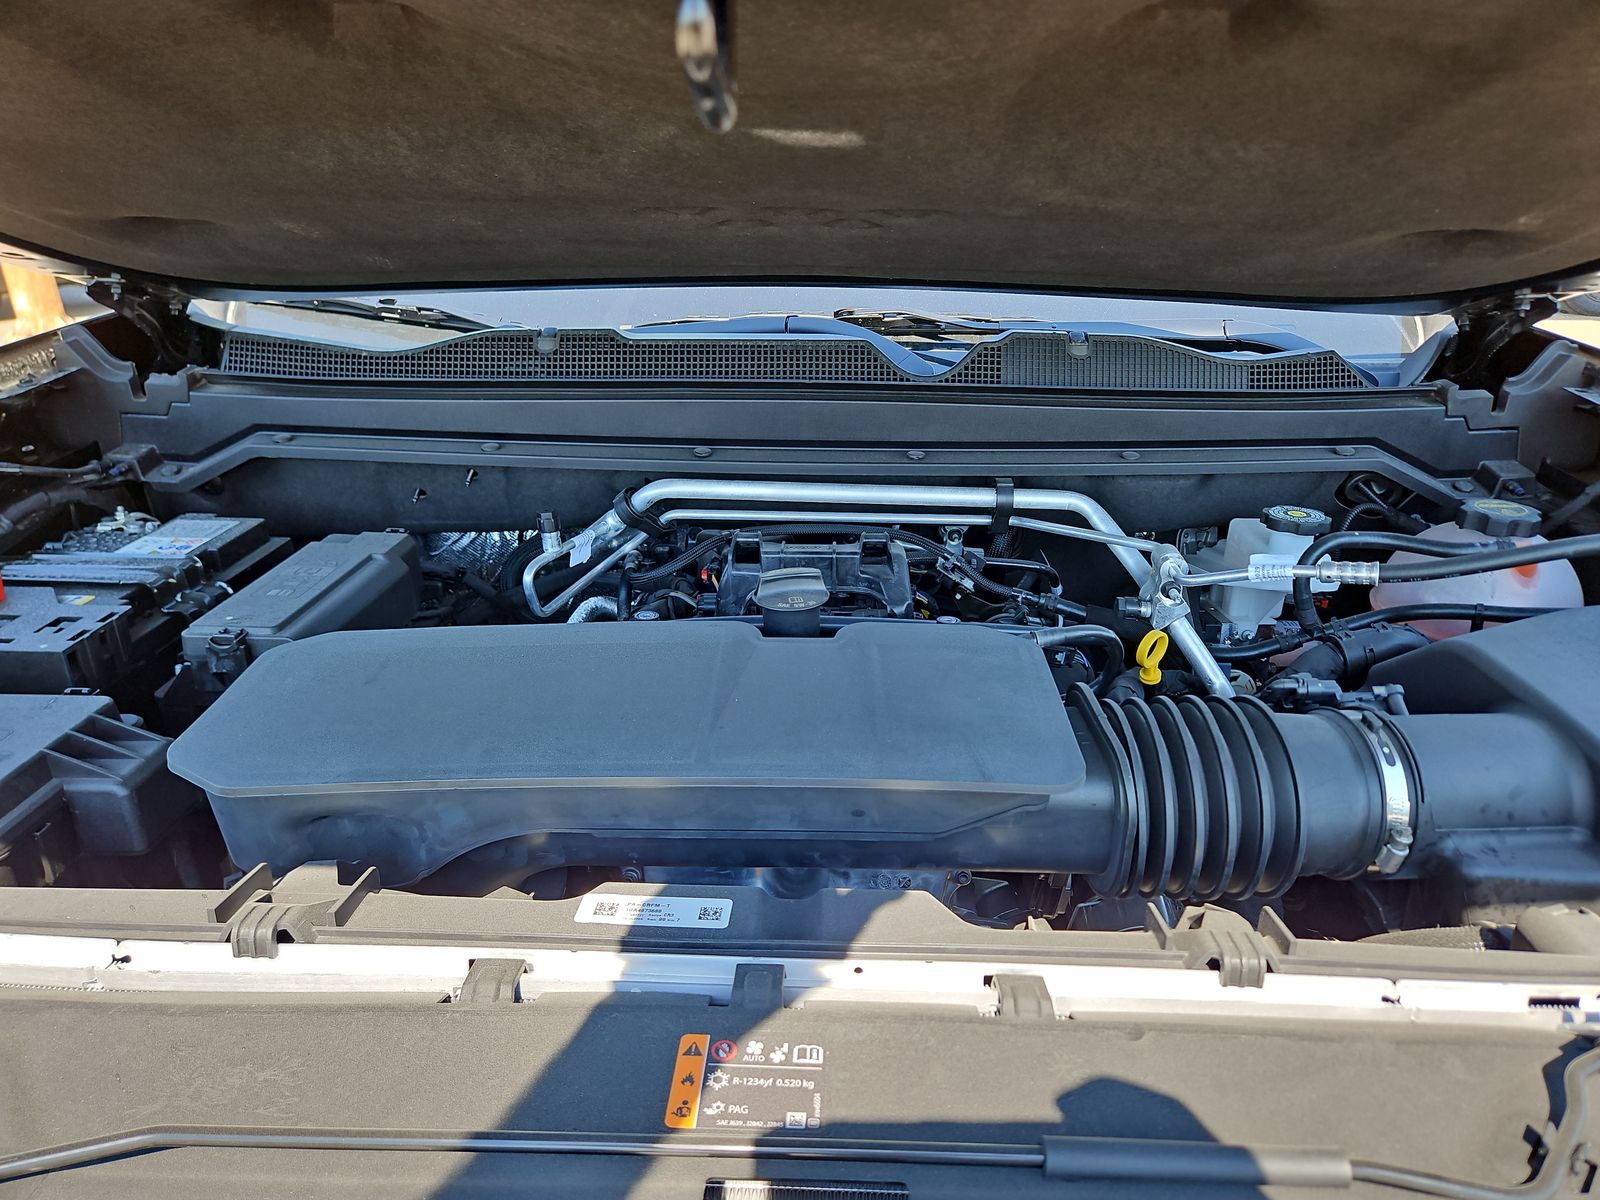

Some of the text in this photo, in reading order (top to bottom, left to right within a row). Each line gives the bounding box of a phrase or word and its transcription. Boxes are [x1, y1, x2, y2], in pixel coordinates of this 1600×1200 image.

[742, 1054, 765, 1062] AUTO
[732, 1077, 815, 1090] R-1234yf 0.520 kg
[728, 1105, 749, 1114] PAG
